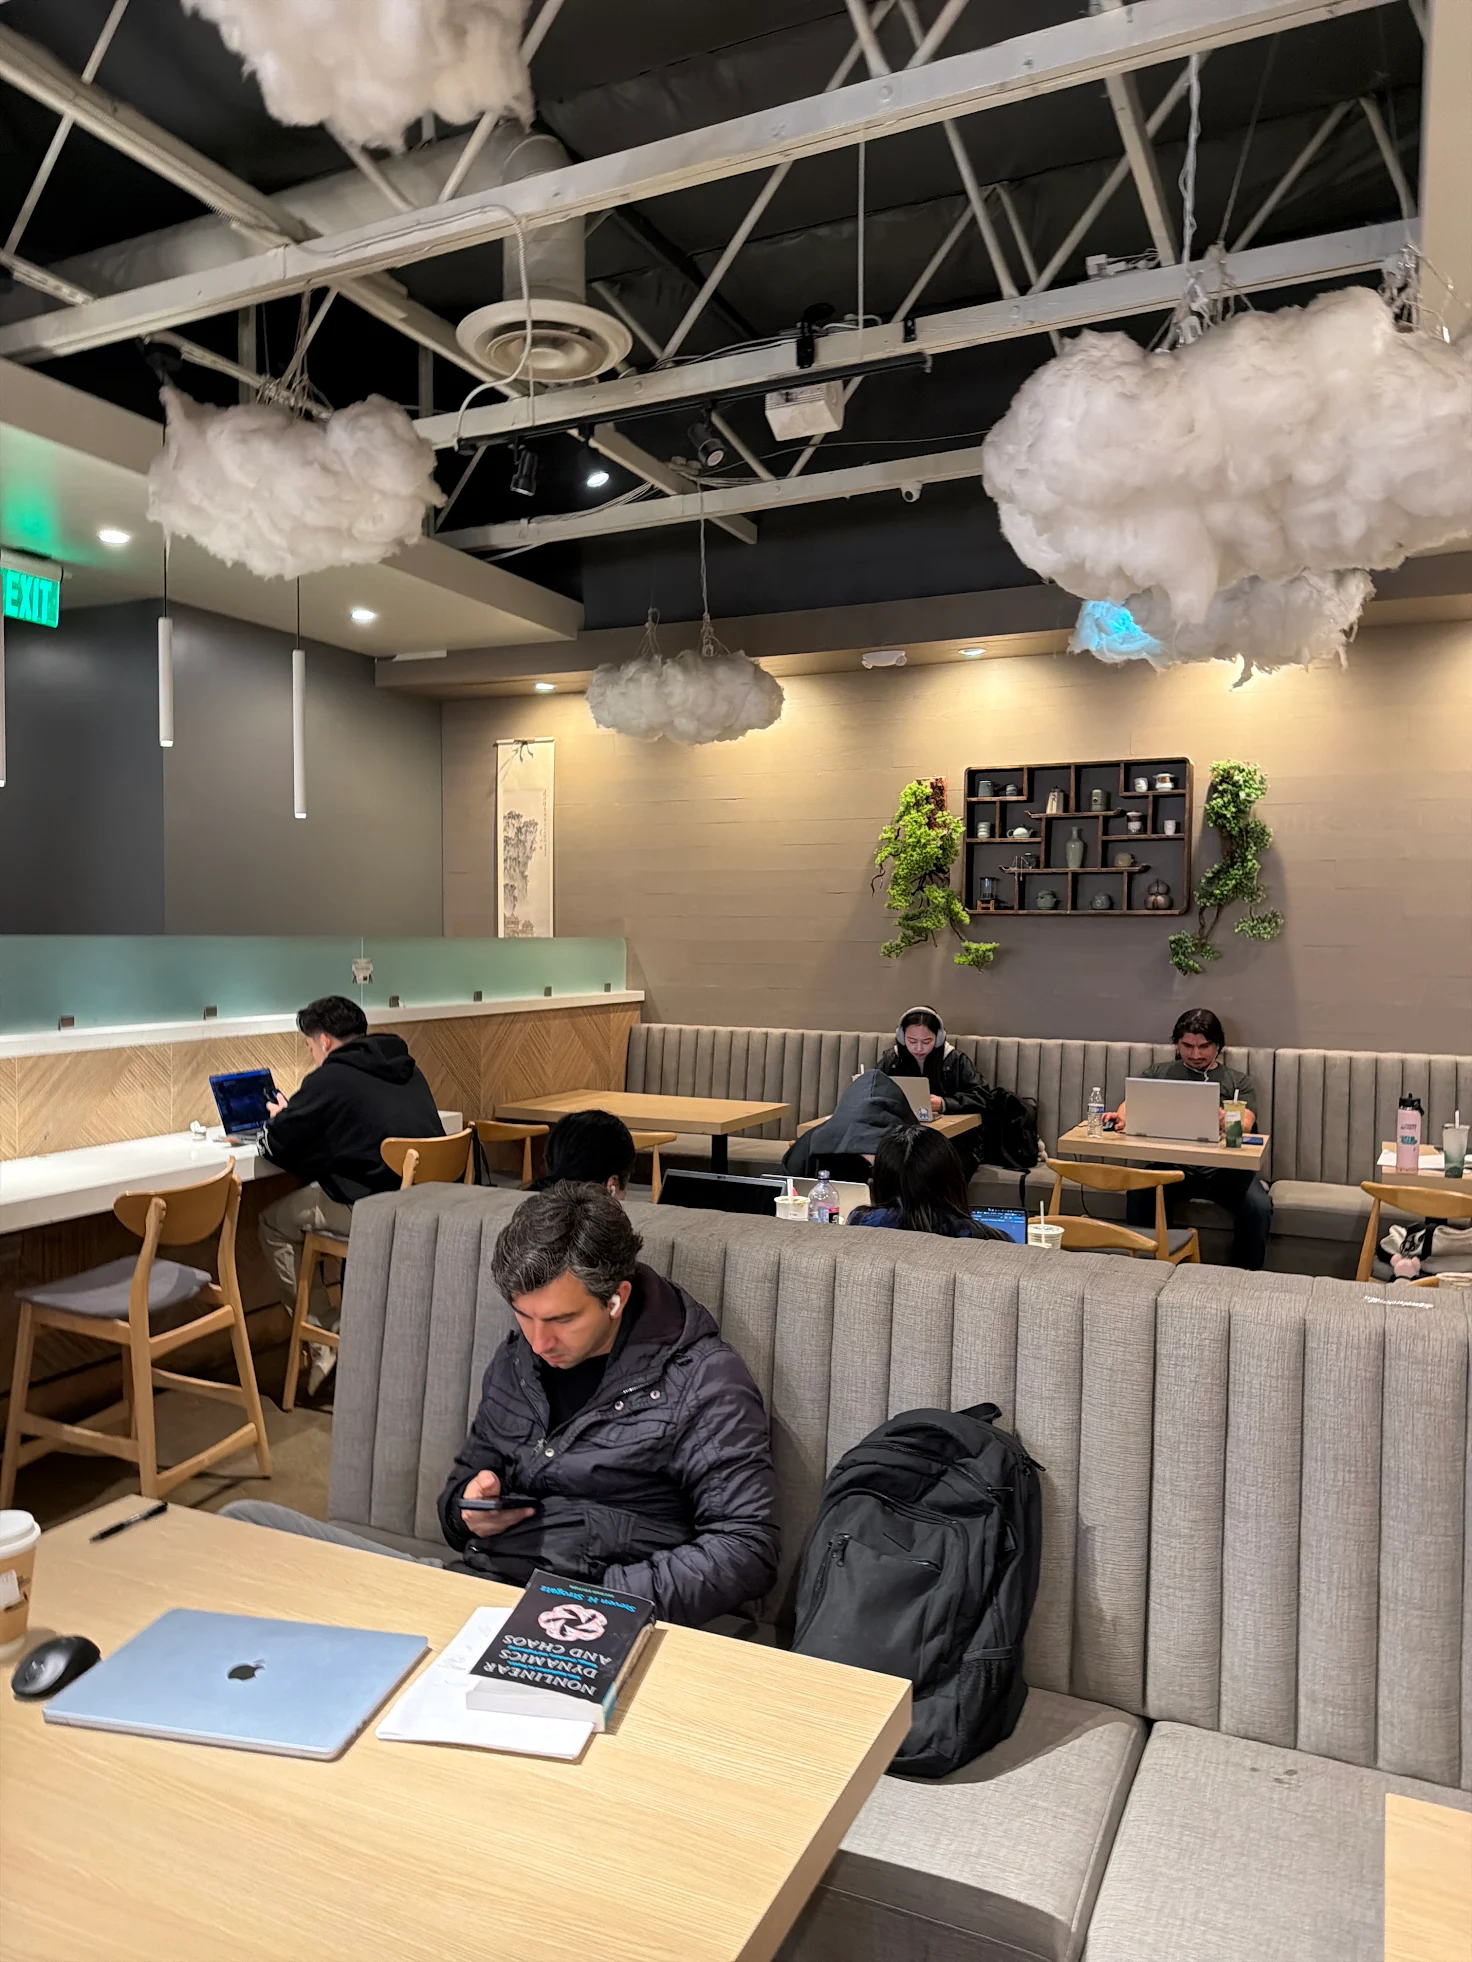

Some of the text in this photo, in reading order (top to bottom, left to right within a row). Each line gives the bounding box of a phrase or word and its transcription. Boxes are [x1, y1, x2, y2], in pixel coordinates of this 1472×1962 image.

[6, 569, 52, 624] EXIT
[502, 1635, 566, 1654] CHAOS
[569, 1648, 613, 1666] AND
[483, 1661, 598, 1696] NONLINEAR
[498, 1649, 598, 1680] DYNAMICS
